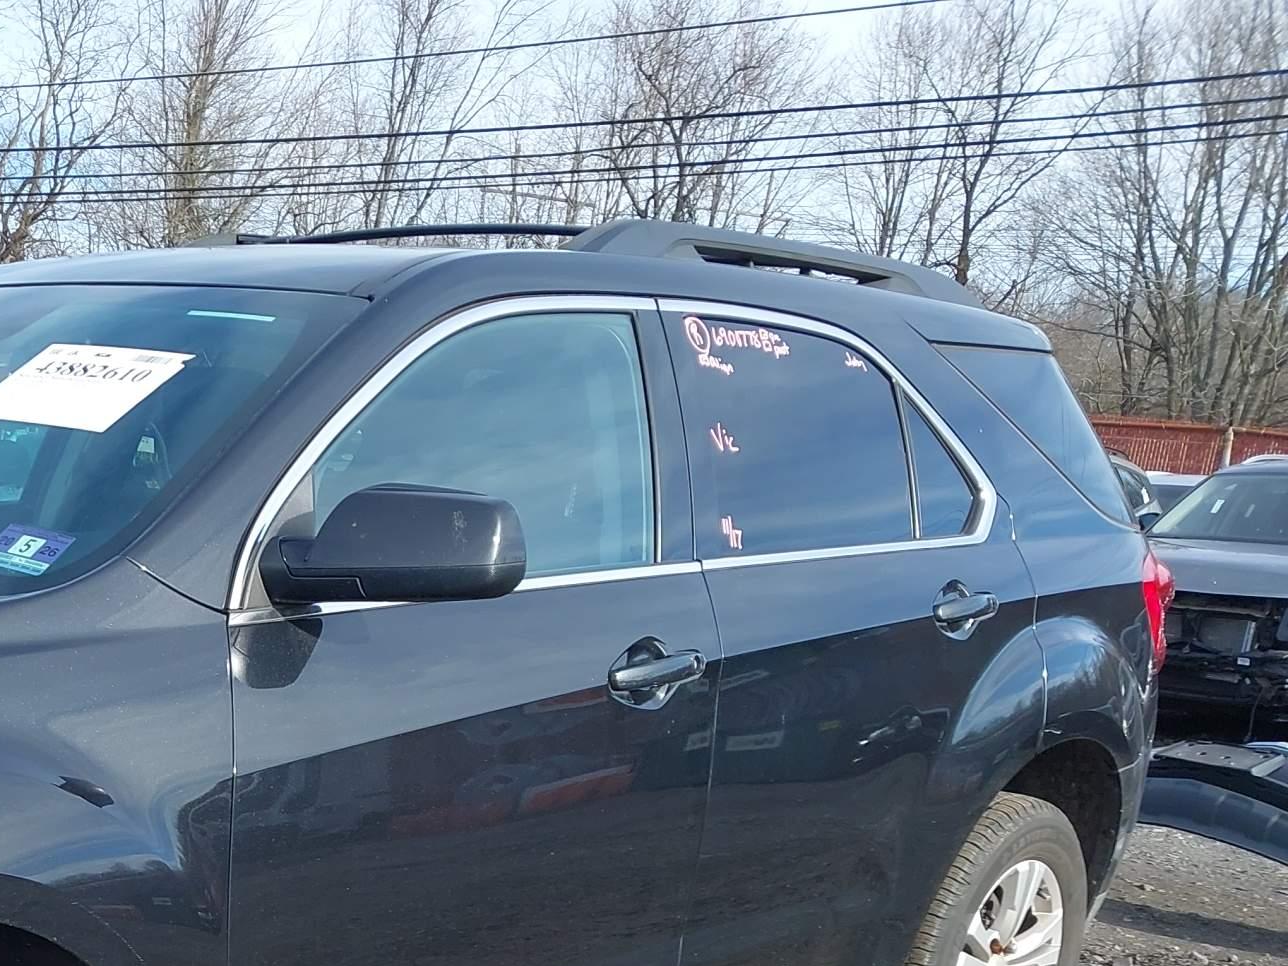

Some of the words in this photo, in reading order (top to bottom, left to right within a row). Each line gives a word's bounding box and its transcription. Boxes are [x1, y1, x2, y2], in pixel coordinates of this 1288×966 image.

[35, 361, 153, 383] 43882610
[18, 538, 38, 554] 5
[39, 545, 61, 558] 26
